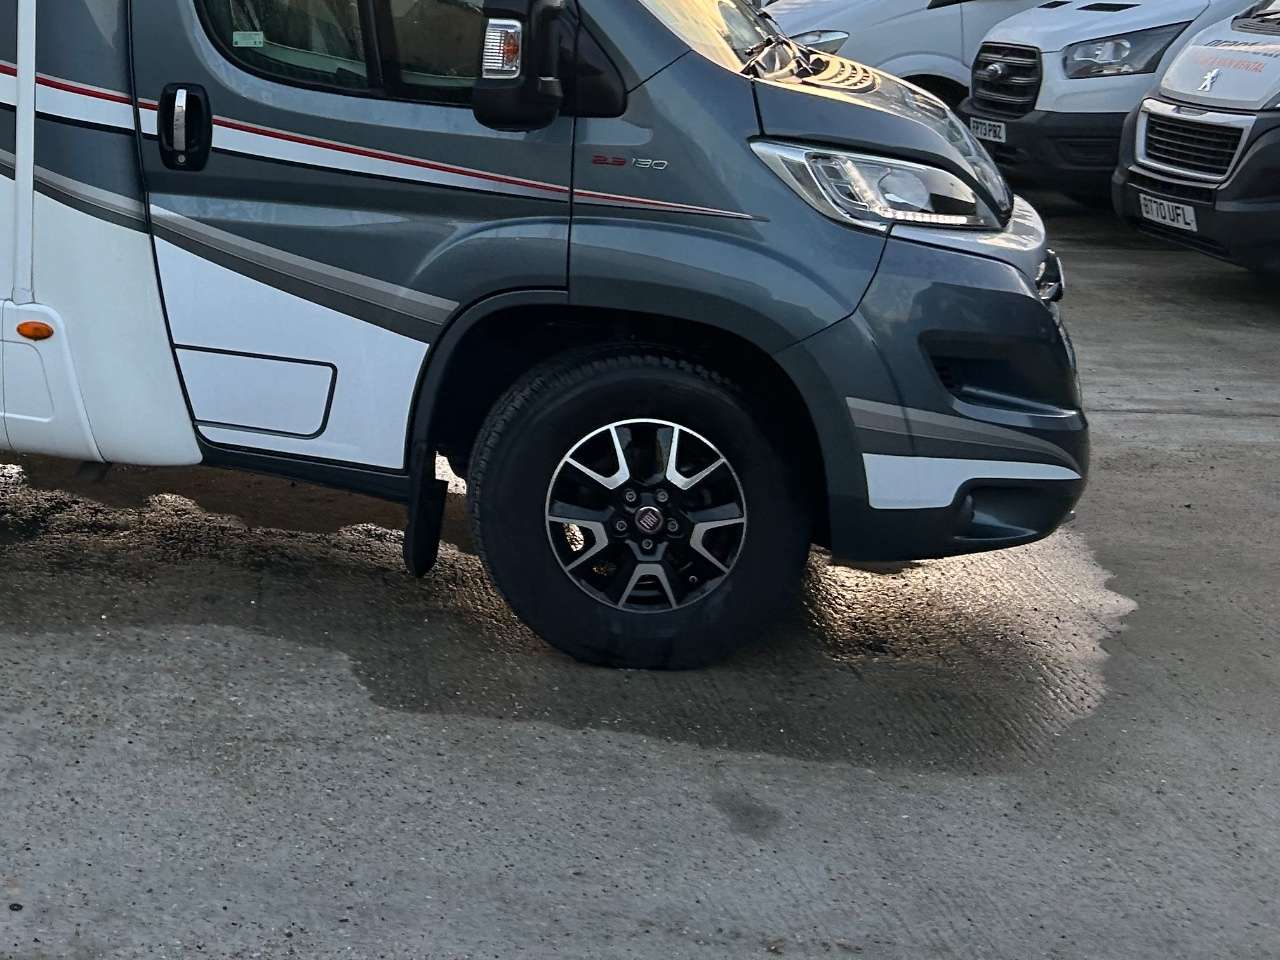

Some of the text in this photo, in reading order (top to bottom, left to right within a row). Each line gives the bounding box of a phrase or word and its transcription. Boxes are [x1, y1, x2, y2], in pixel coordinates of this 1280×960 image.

[632, 158, 668, 170] 130
[1143, 197, 1191, 226] BT70 UFL
[639, 511, 658, 529] FIAT
